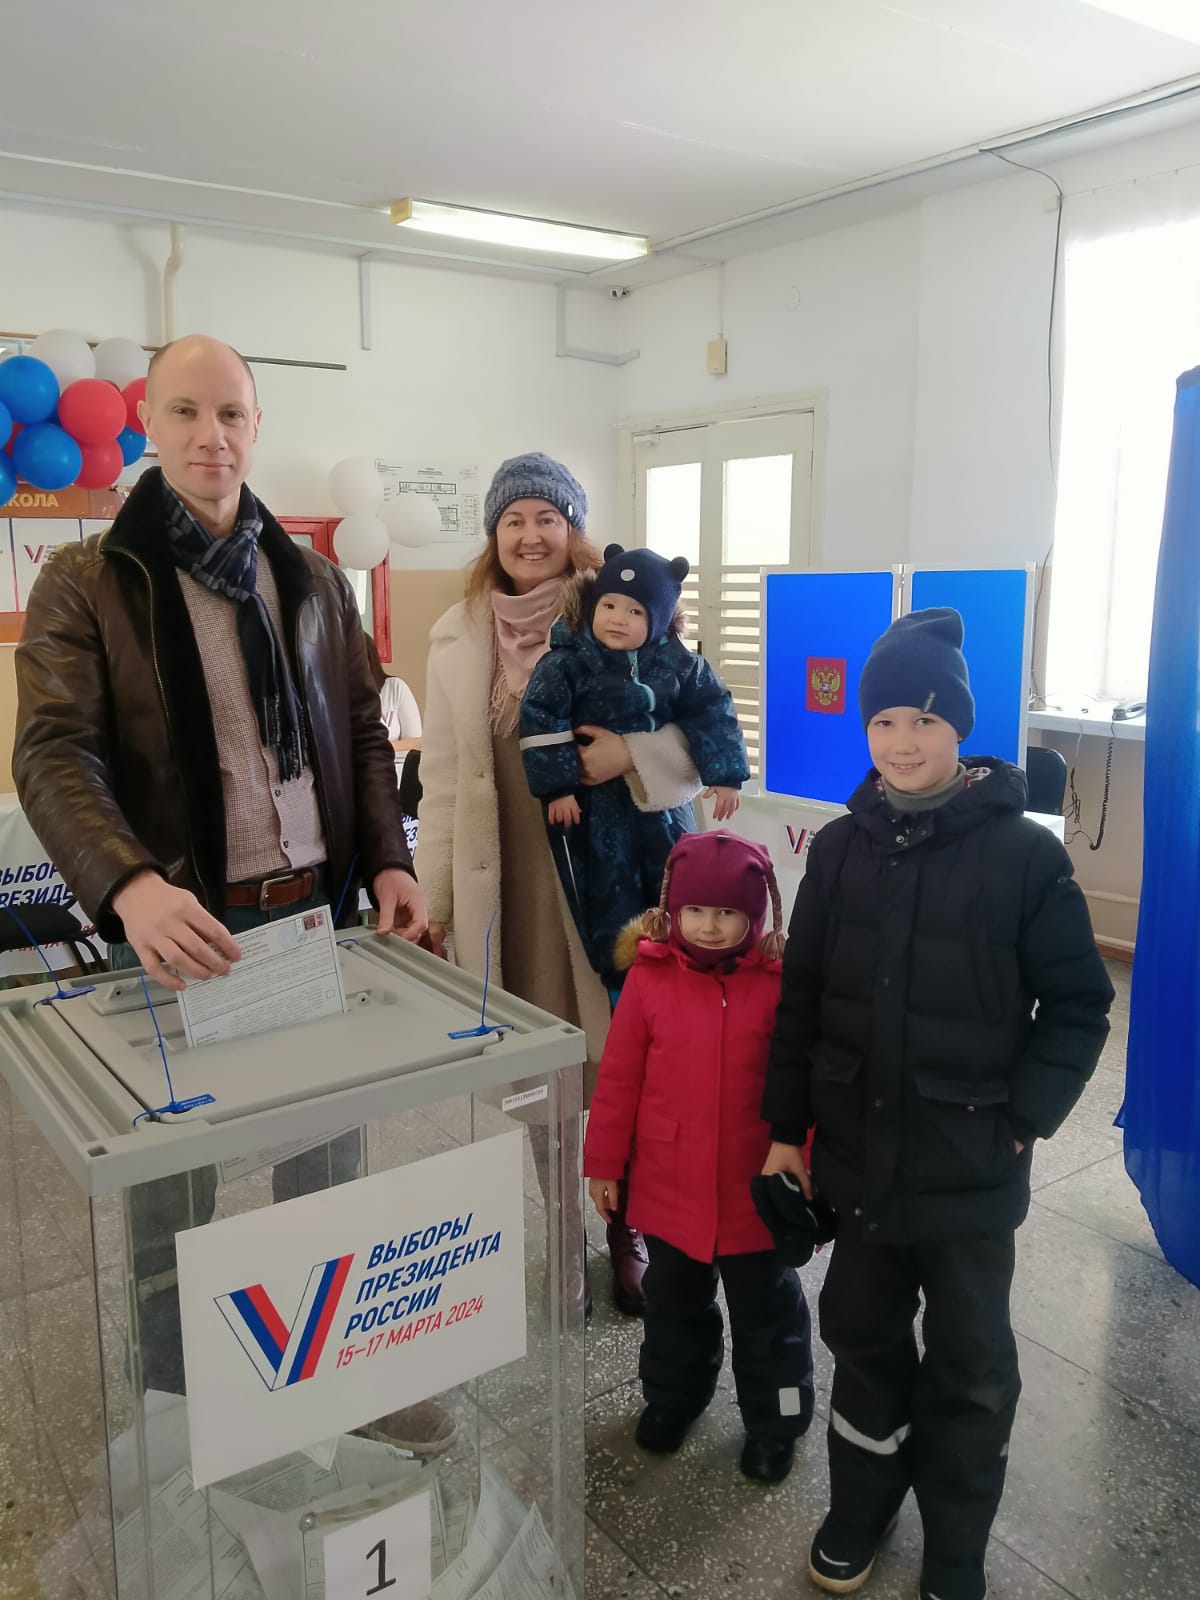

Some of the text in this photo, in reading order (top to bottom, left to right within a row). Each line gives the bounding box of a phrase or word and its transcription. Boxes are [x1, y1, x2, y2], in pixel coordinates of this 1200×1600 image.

[4, 493, 59, 508] КОЛА
[0, 862, 58, 886] ЫБОР
[355, 1231, 501, 1305] ПРЕЗИДЕНТА
[367, 1212, 473, 1270] ВЫБОРЫ
[344, 1283, 442, 1339] РОССИИ
[385, 1311, 443, 1350] МАРТА
[445, 1295, 484, 1327] 2024
[366, 1538, 397, 1597] 1
